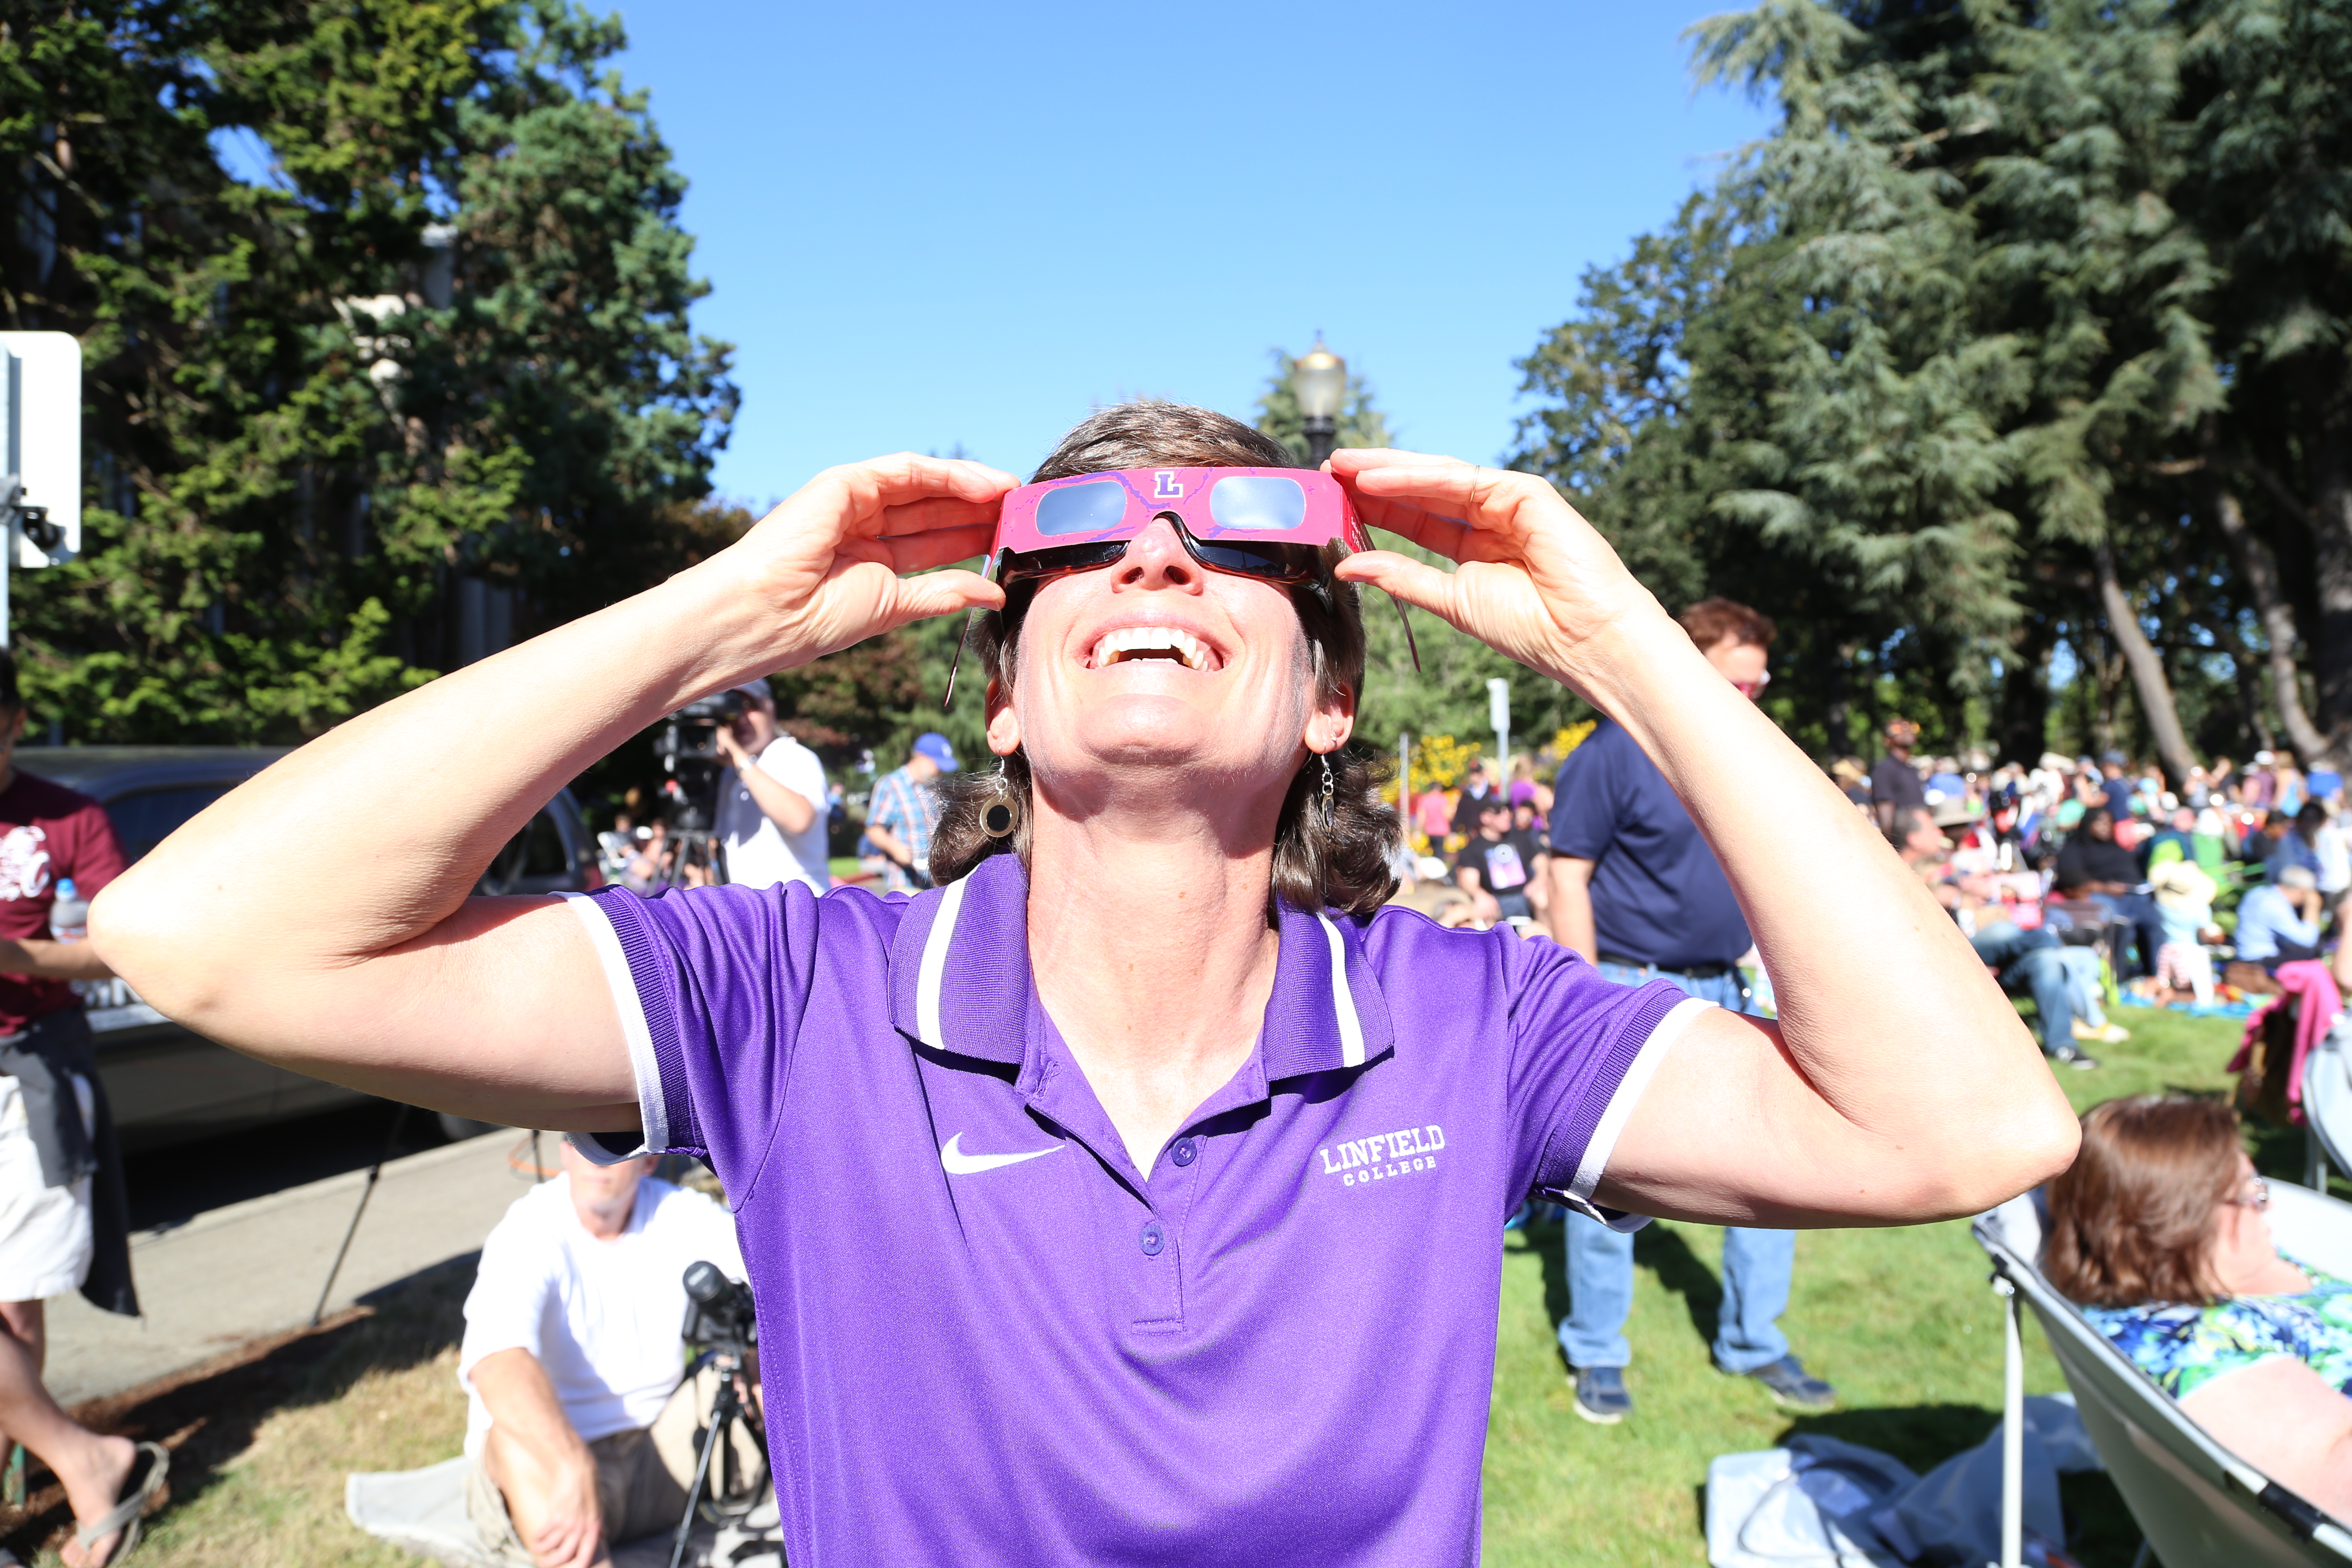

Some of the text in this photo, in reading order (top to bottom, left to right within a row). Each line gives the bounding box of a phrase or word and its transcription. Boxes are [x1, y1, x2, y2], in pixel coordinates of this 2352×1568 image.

[1155, 472, 1182, 497] L
[1320, 1125, 1446, 1174] LINFIELD
[1343, 1156, 1436, 1186] COLLEGE
